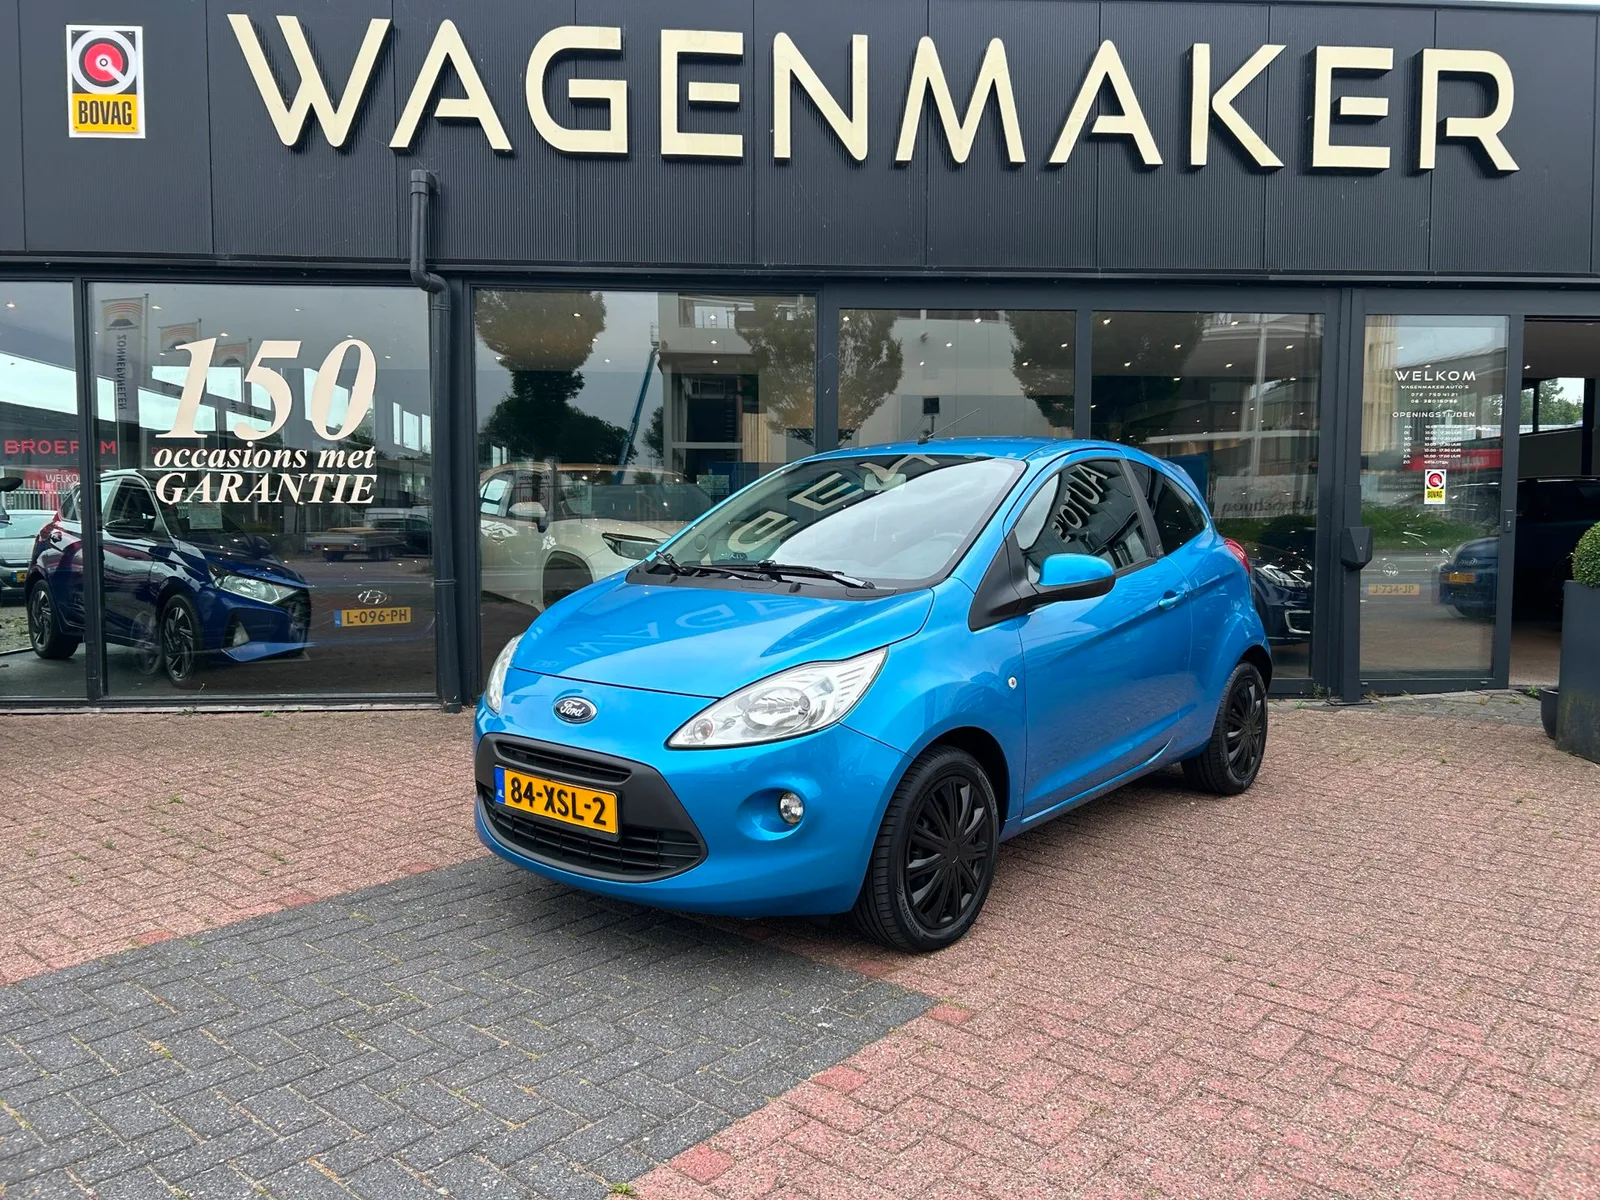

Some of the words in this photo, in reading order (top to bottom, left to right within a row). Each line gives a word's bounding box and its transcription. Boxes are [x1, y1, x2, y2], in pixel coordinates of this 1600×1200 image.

[227, 14, 1519, 171] WAGENMAKER
[78, 100, 133, 126] BOVAG
[1394, 370, 1476, 381] WELKOM
[155, 337, 377, 441] 150
[153, 441, 308, 469] occasions
[318, 446, 376, 469] met
[45, 474, 80, 483] WELKO
[155, 472, 378, 505] GARANTIE
[1373, 584, 1415, 593] J-734-JP
[346, 609, 407, 624] L-096-PH
[560, 700, 585, 717] Ford
[510, 777, 607, 826] 84-XSL-2
